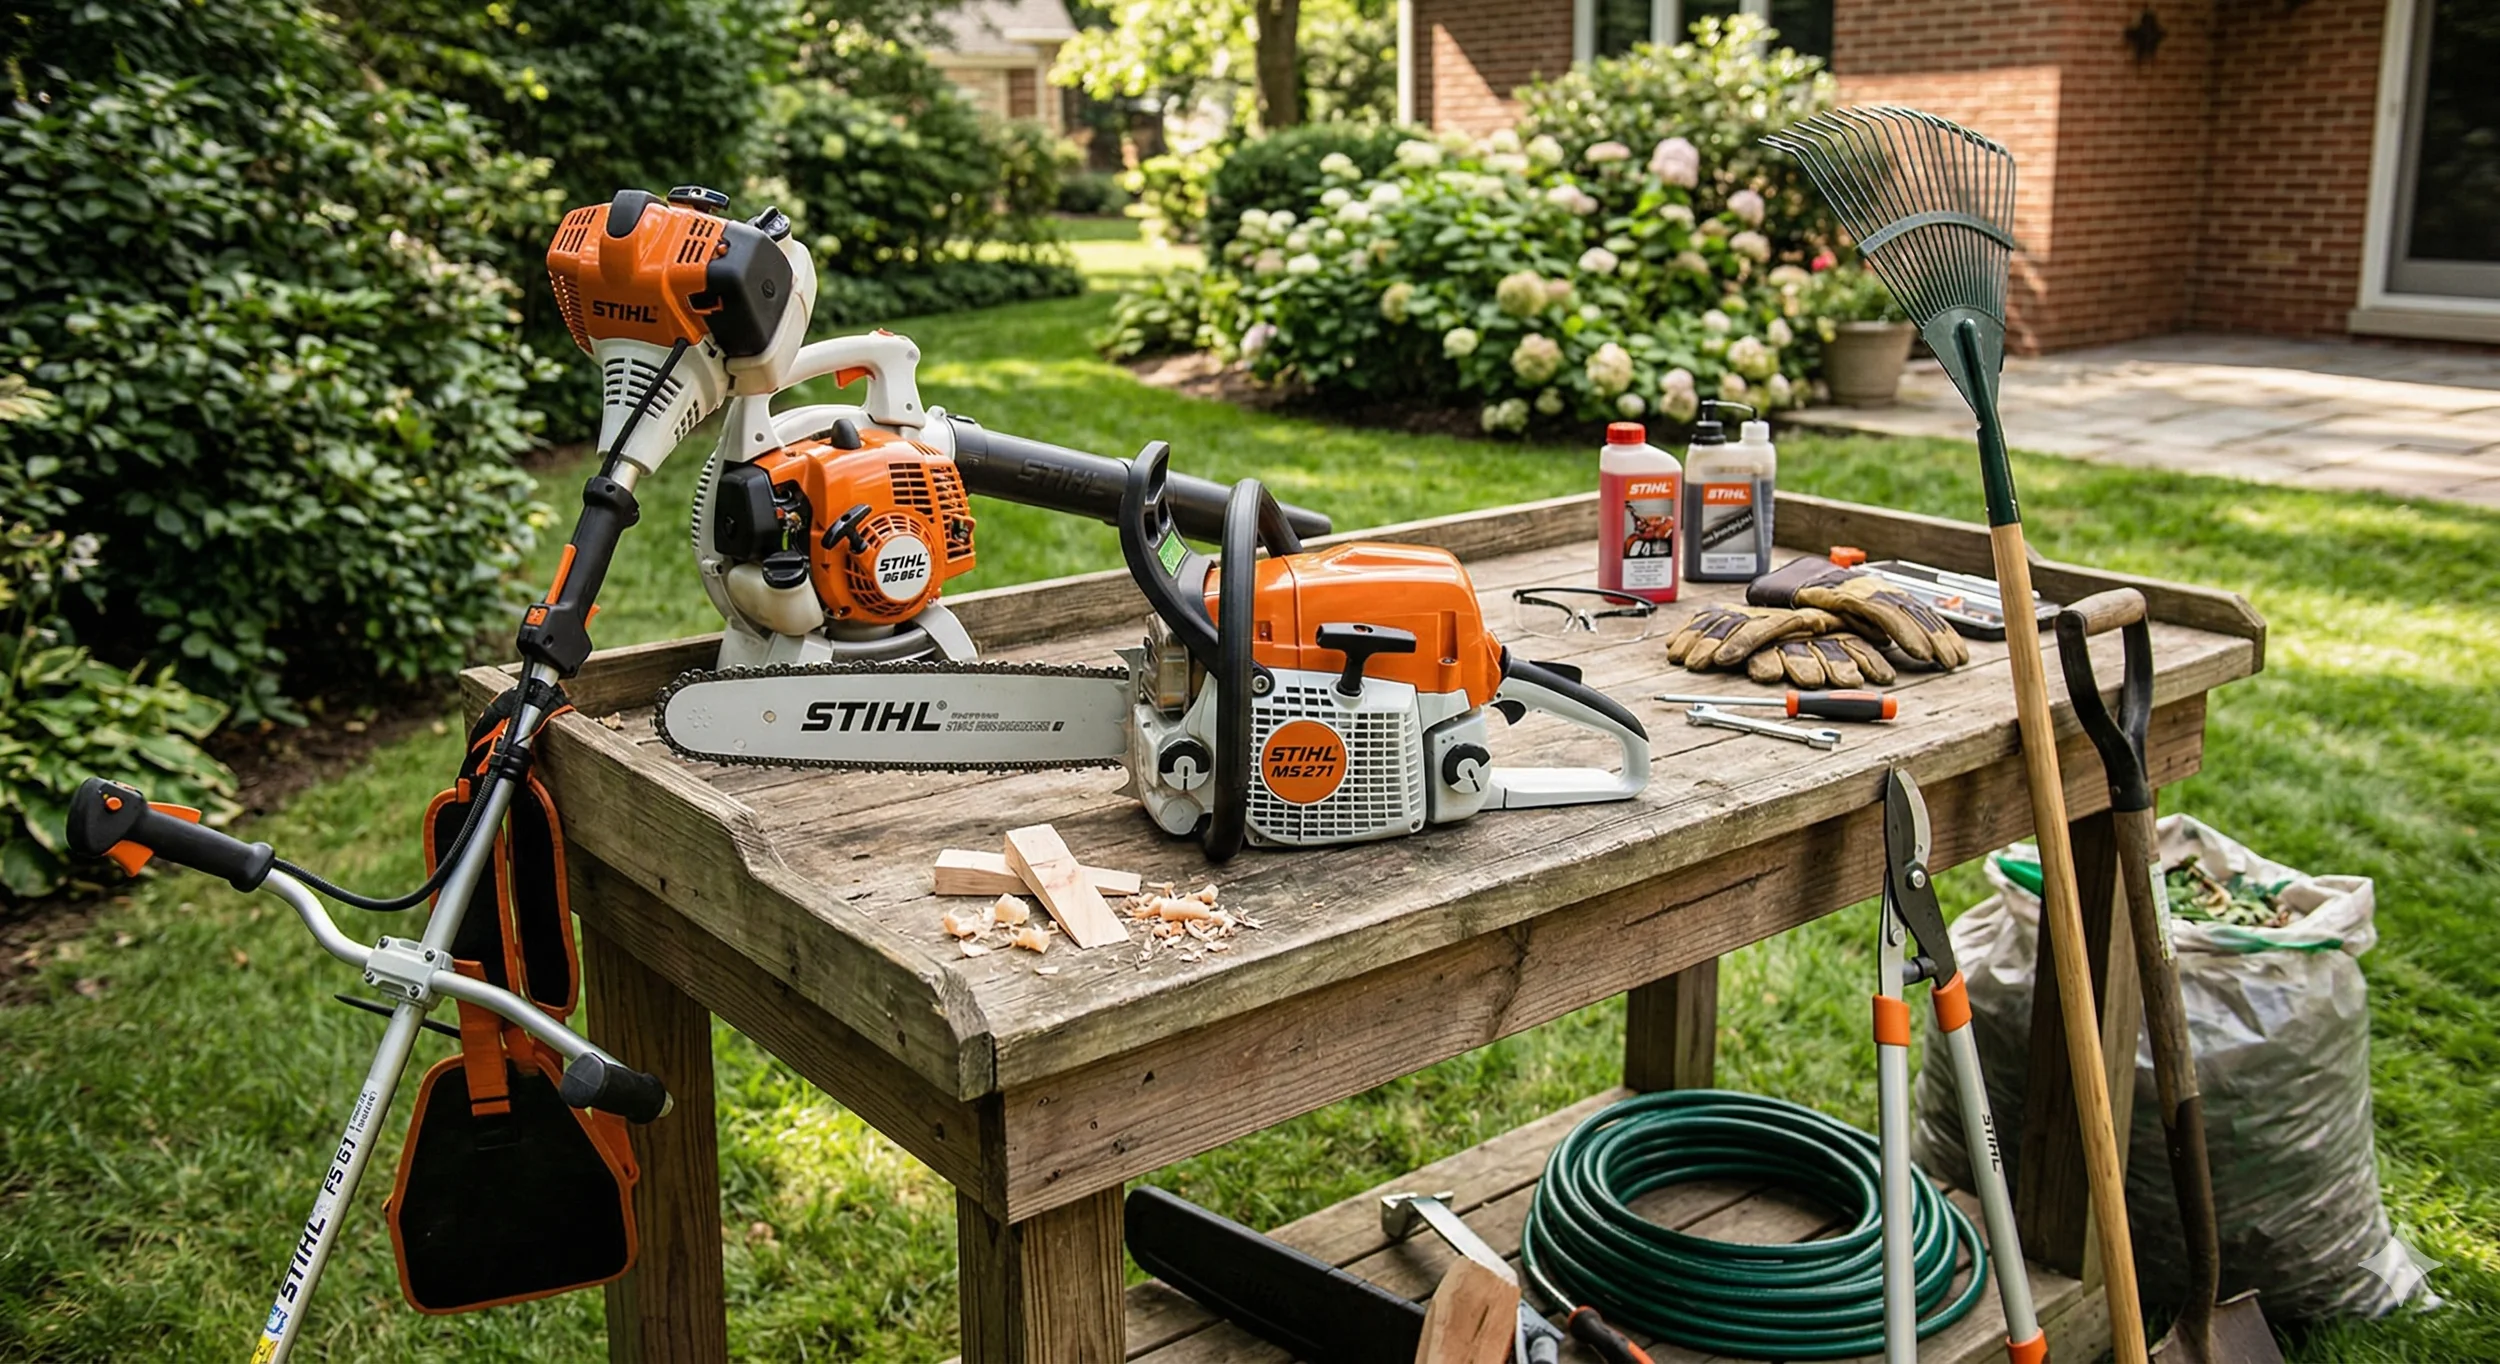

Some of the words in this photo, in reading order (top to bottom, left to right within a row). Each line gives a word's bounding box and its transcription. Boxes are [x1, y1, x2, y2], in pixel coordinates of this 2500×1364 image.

[592, 300, 657, 323] STIHL
[1017, 458, 1105, 495] STIHL
[1629, 483, 1671, 495] STIHL
[878, 553, 926, 572] STIHL
[916, 567, 925, 578] C
[800, 701, 941, 732] STIHL
[1269, 745, 1337, 762] STIHL
[1271, 765, 1302, 778] MS
[1302, 765, 1334, 778] 271
[1981, 1114, 2001, 1172] STIHL
[280, 1216, 326, 1304] STIHL
[324, 1166, 344, 1196] FS
